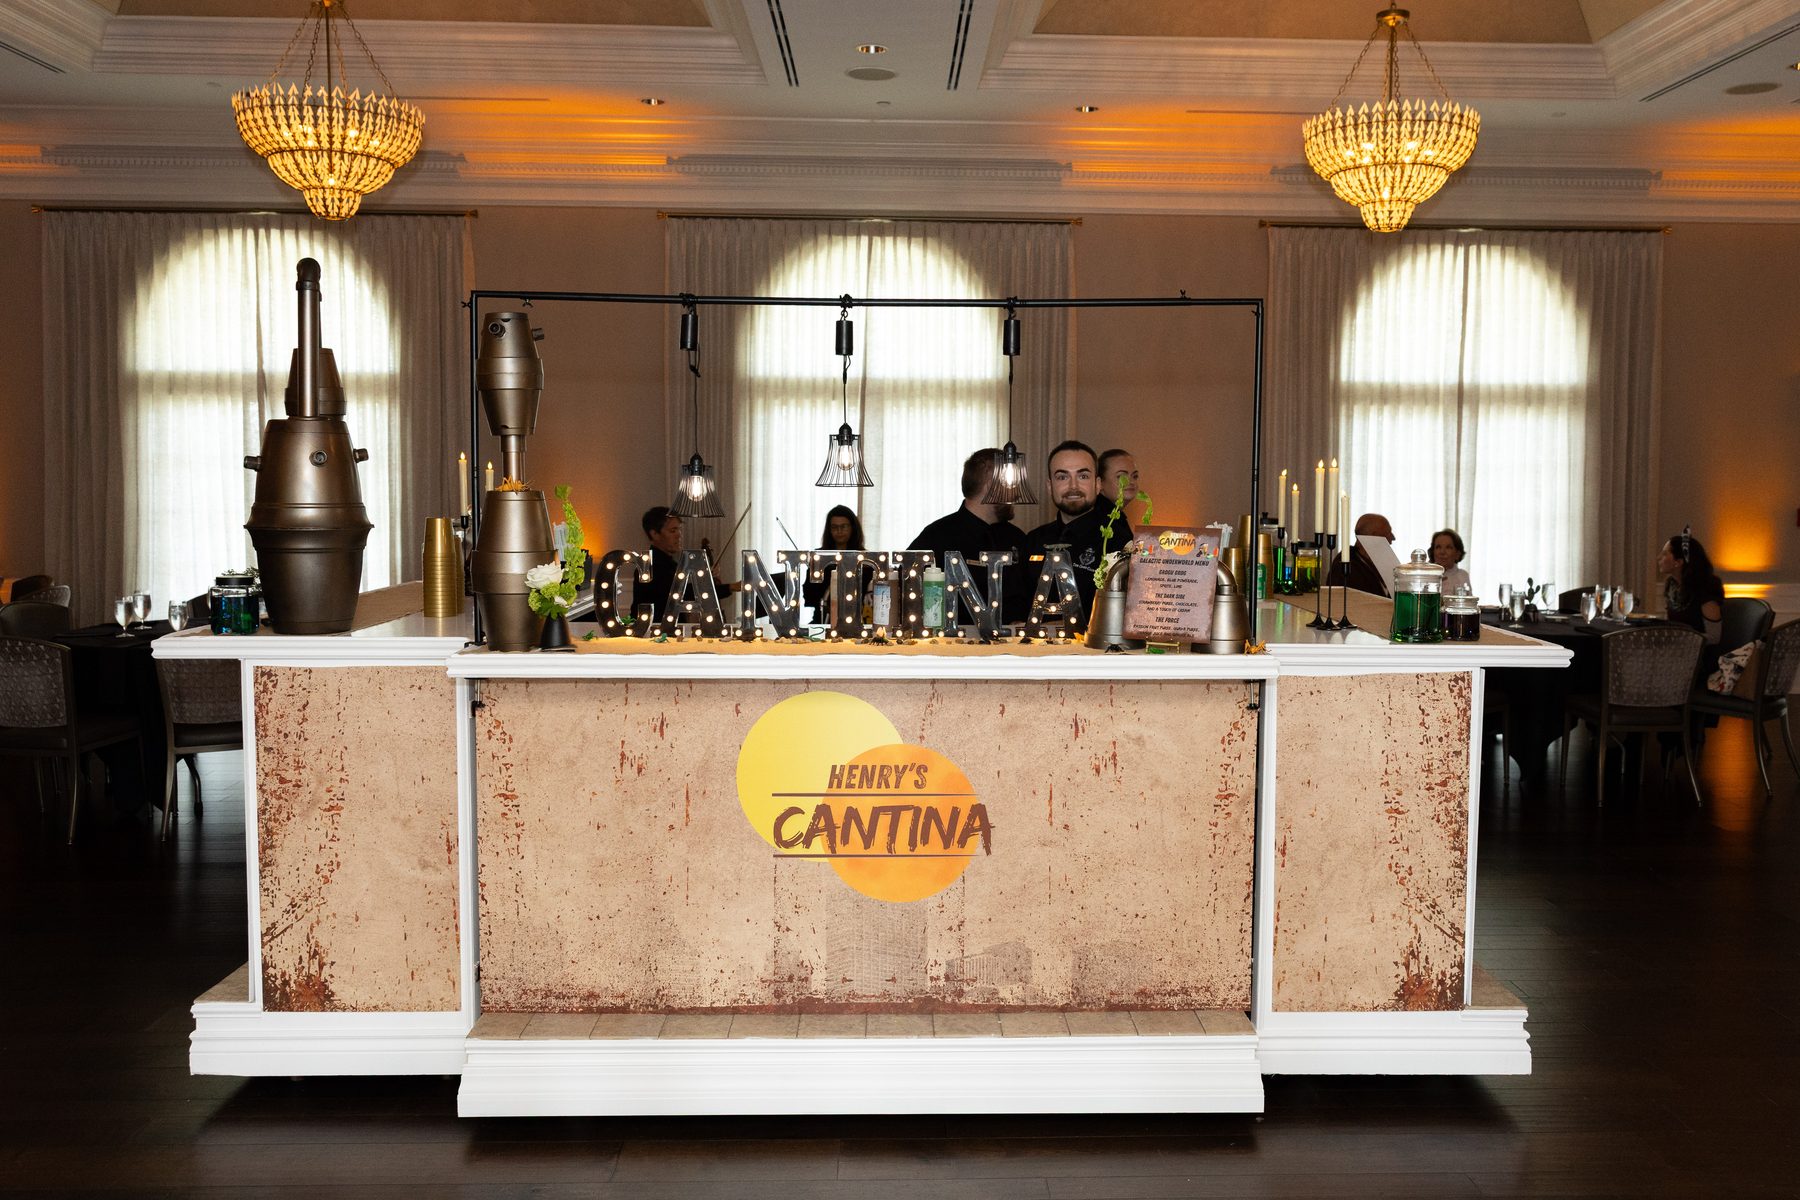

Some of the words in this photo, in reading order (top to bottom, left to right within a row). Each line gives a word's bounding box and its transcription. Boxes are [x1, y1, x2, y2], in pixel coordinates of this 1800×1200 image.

[1160, 537, 1196, 548] CANTINA
[595, 549, 1088, 639] CANTINA
[828, 763, 928, 790] HENRY'S
[773, 803, 996, 856] CANTINA
